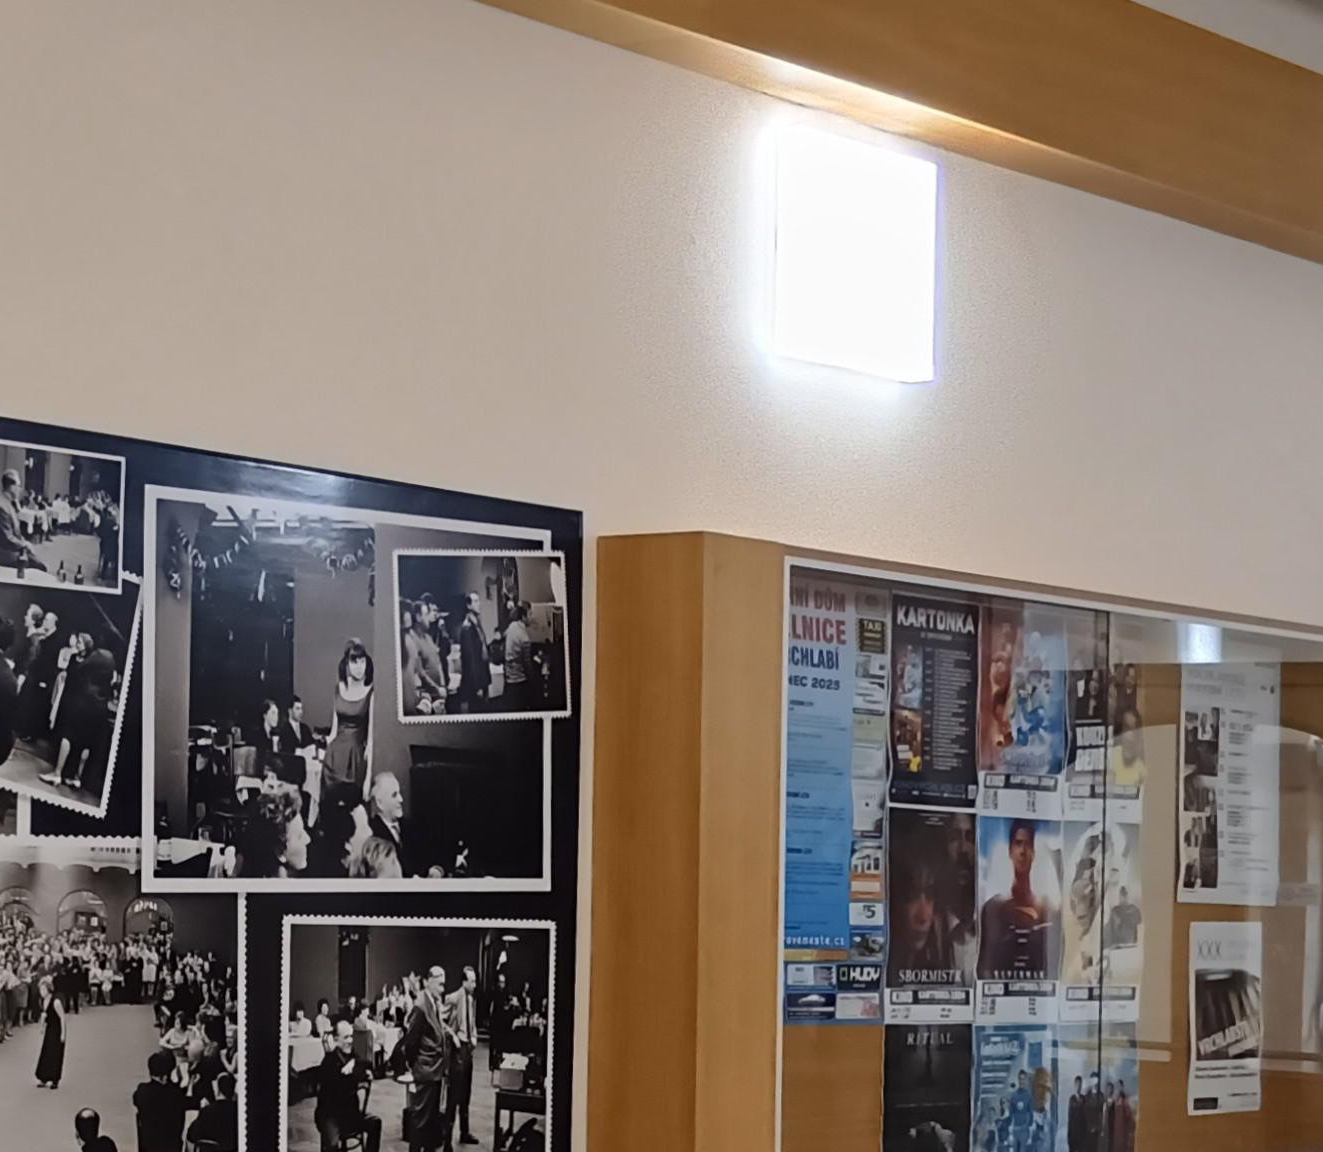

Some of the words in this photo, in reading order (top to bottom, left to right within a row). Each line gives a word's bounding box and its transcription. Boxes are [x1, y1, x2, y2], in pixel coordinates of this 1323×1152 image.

[897, 605, 975, 635] KARTONKA
[789, 613, 846, 645] LNICE
[789, 646, 840, 670] CHLABÍ
[811, 677, 840, 690] 2025
[850, 967, 880, 982] HUDY
[898, 969, 964, 983] SBORMISTR
[906, 1032, 955, 1046] RITUAL
